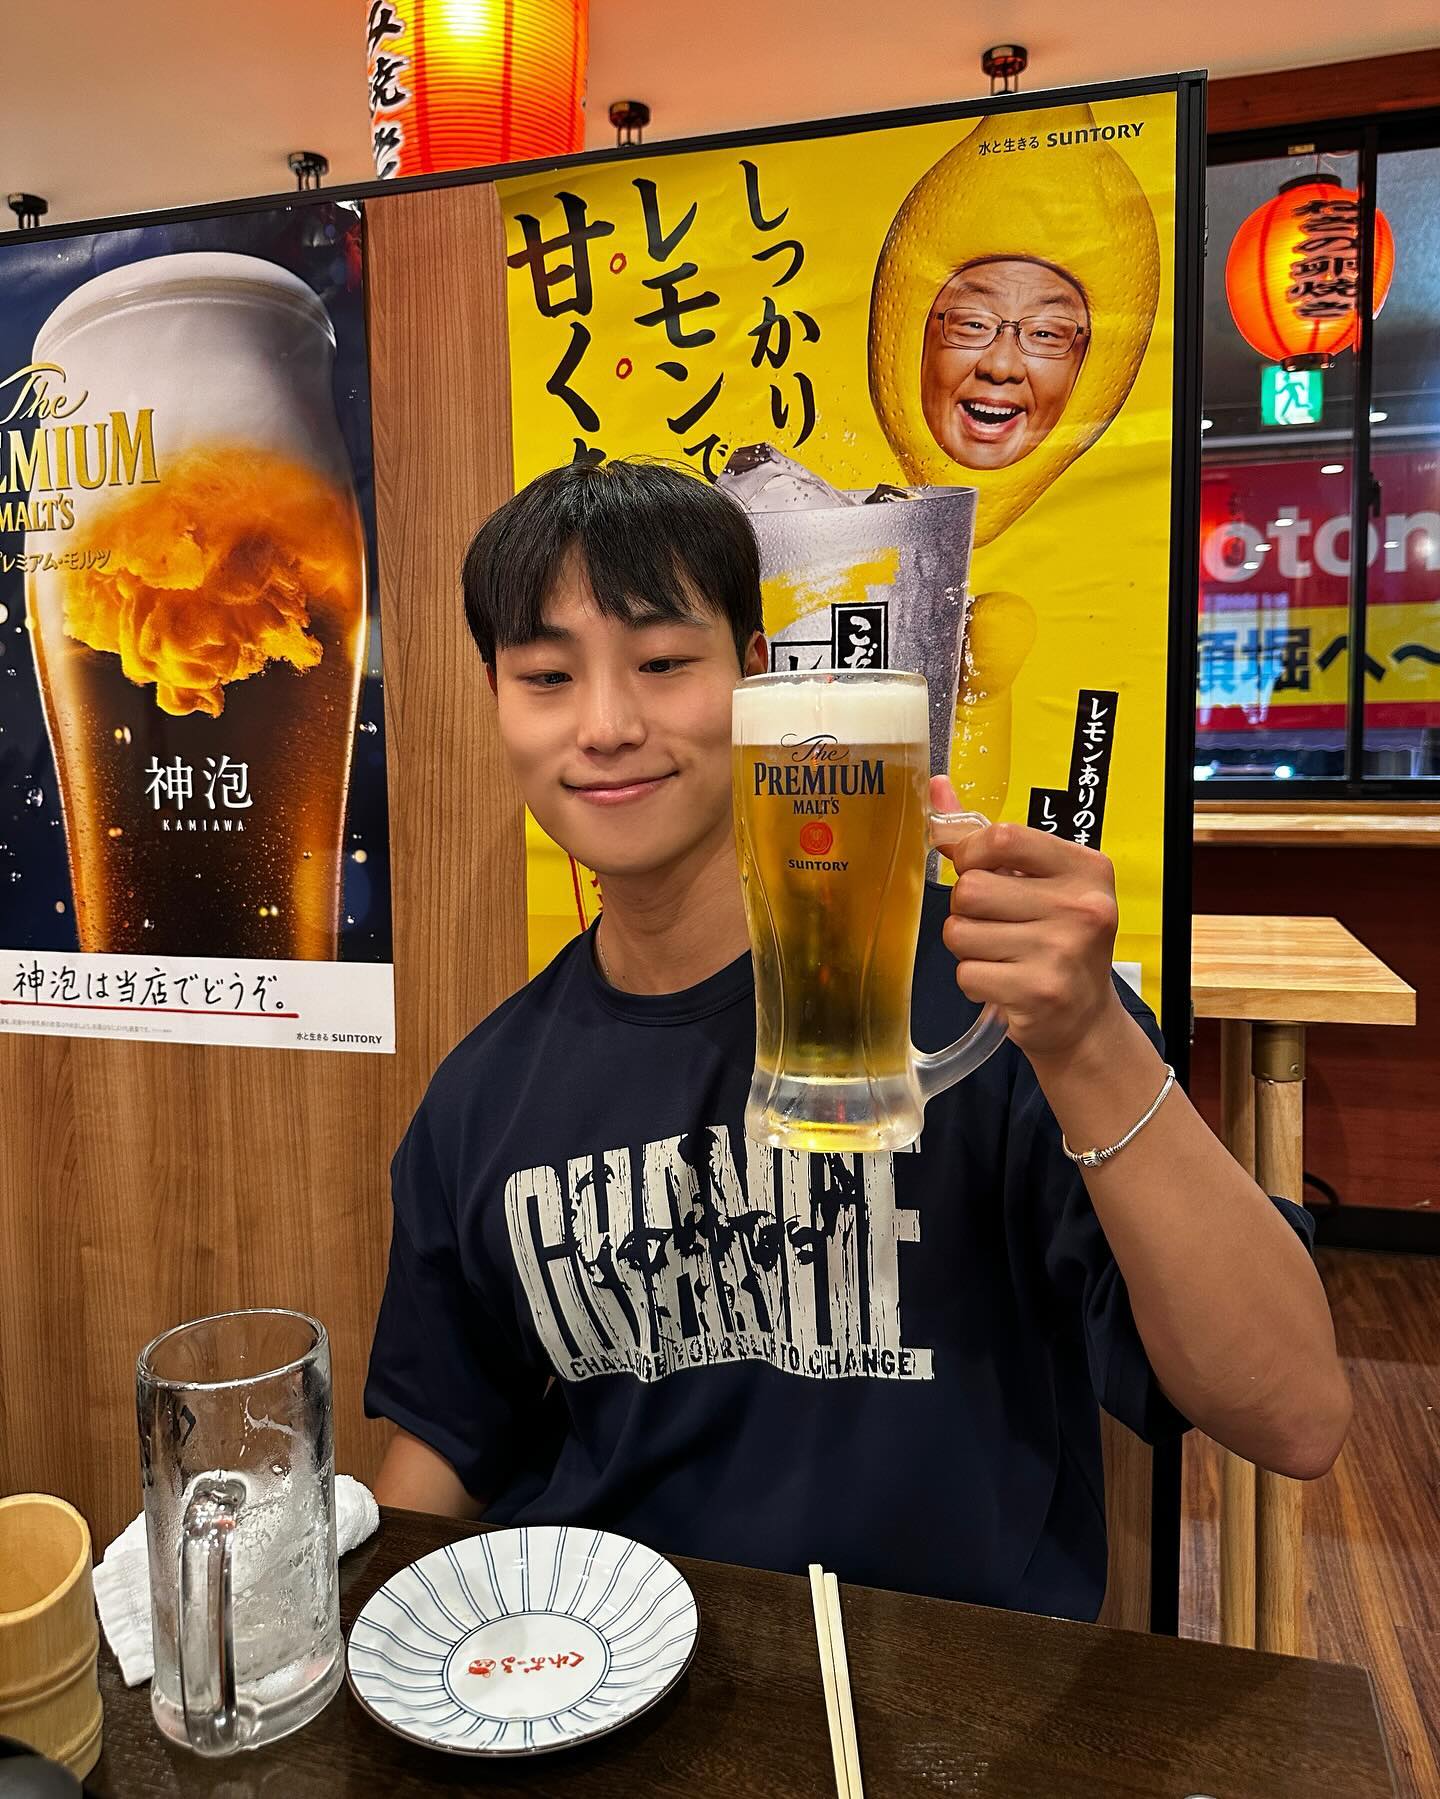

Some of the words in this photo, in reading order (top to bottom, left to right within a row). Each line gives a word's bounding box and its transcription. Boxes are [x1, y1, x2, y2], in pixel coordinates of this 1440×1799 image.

[978, 137, 1039, 156] 水と生きる
[1047, 122, 1145, 147] SUNTORY
[739, 160, 820, 447] しっかり
[632, 177, 728, 484] レモンで
[0, 362, 89, 424] The
[780, 733, 849, 762] The
[144, 755, 253, 811] 神泡
[753, 760, 886, 796] PREMIUM
[793, 797, 840, 815] MALT'S
[163, 819, 246, 832] KAMIAWA
[788, 859, 849, 872] SUNTORY
[12, 959, 285, 1012] 神泡は当店でどうぞ。
[296, 1032, 329, 1041] 水と生きる
[332, 1034, 383, 1044] SUNTORY
[809, 1348, 913, 1377] CHANGE
